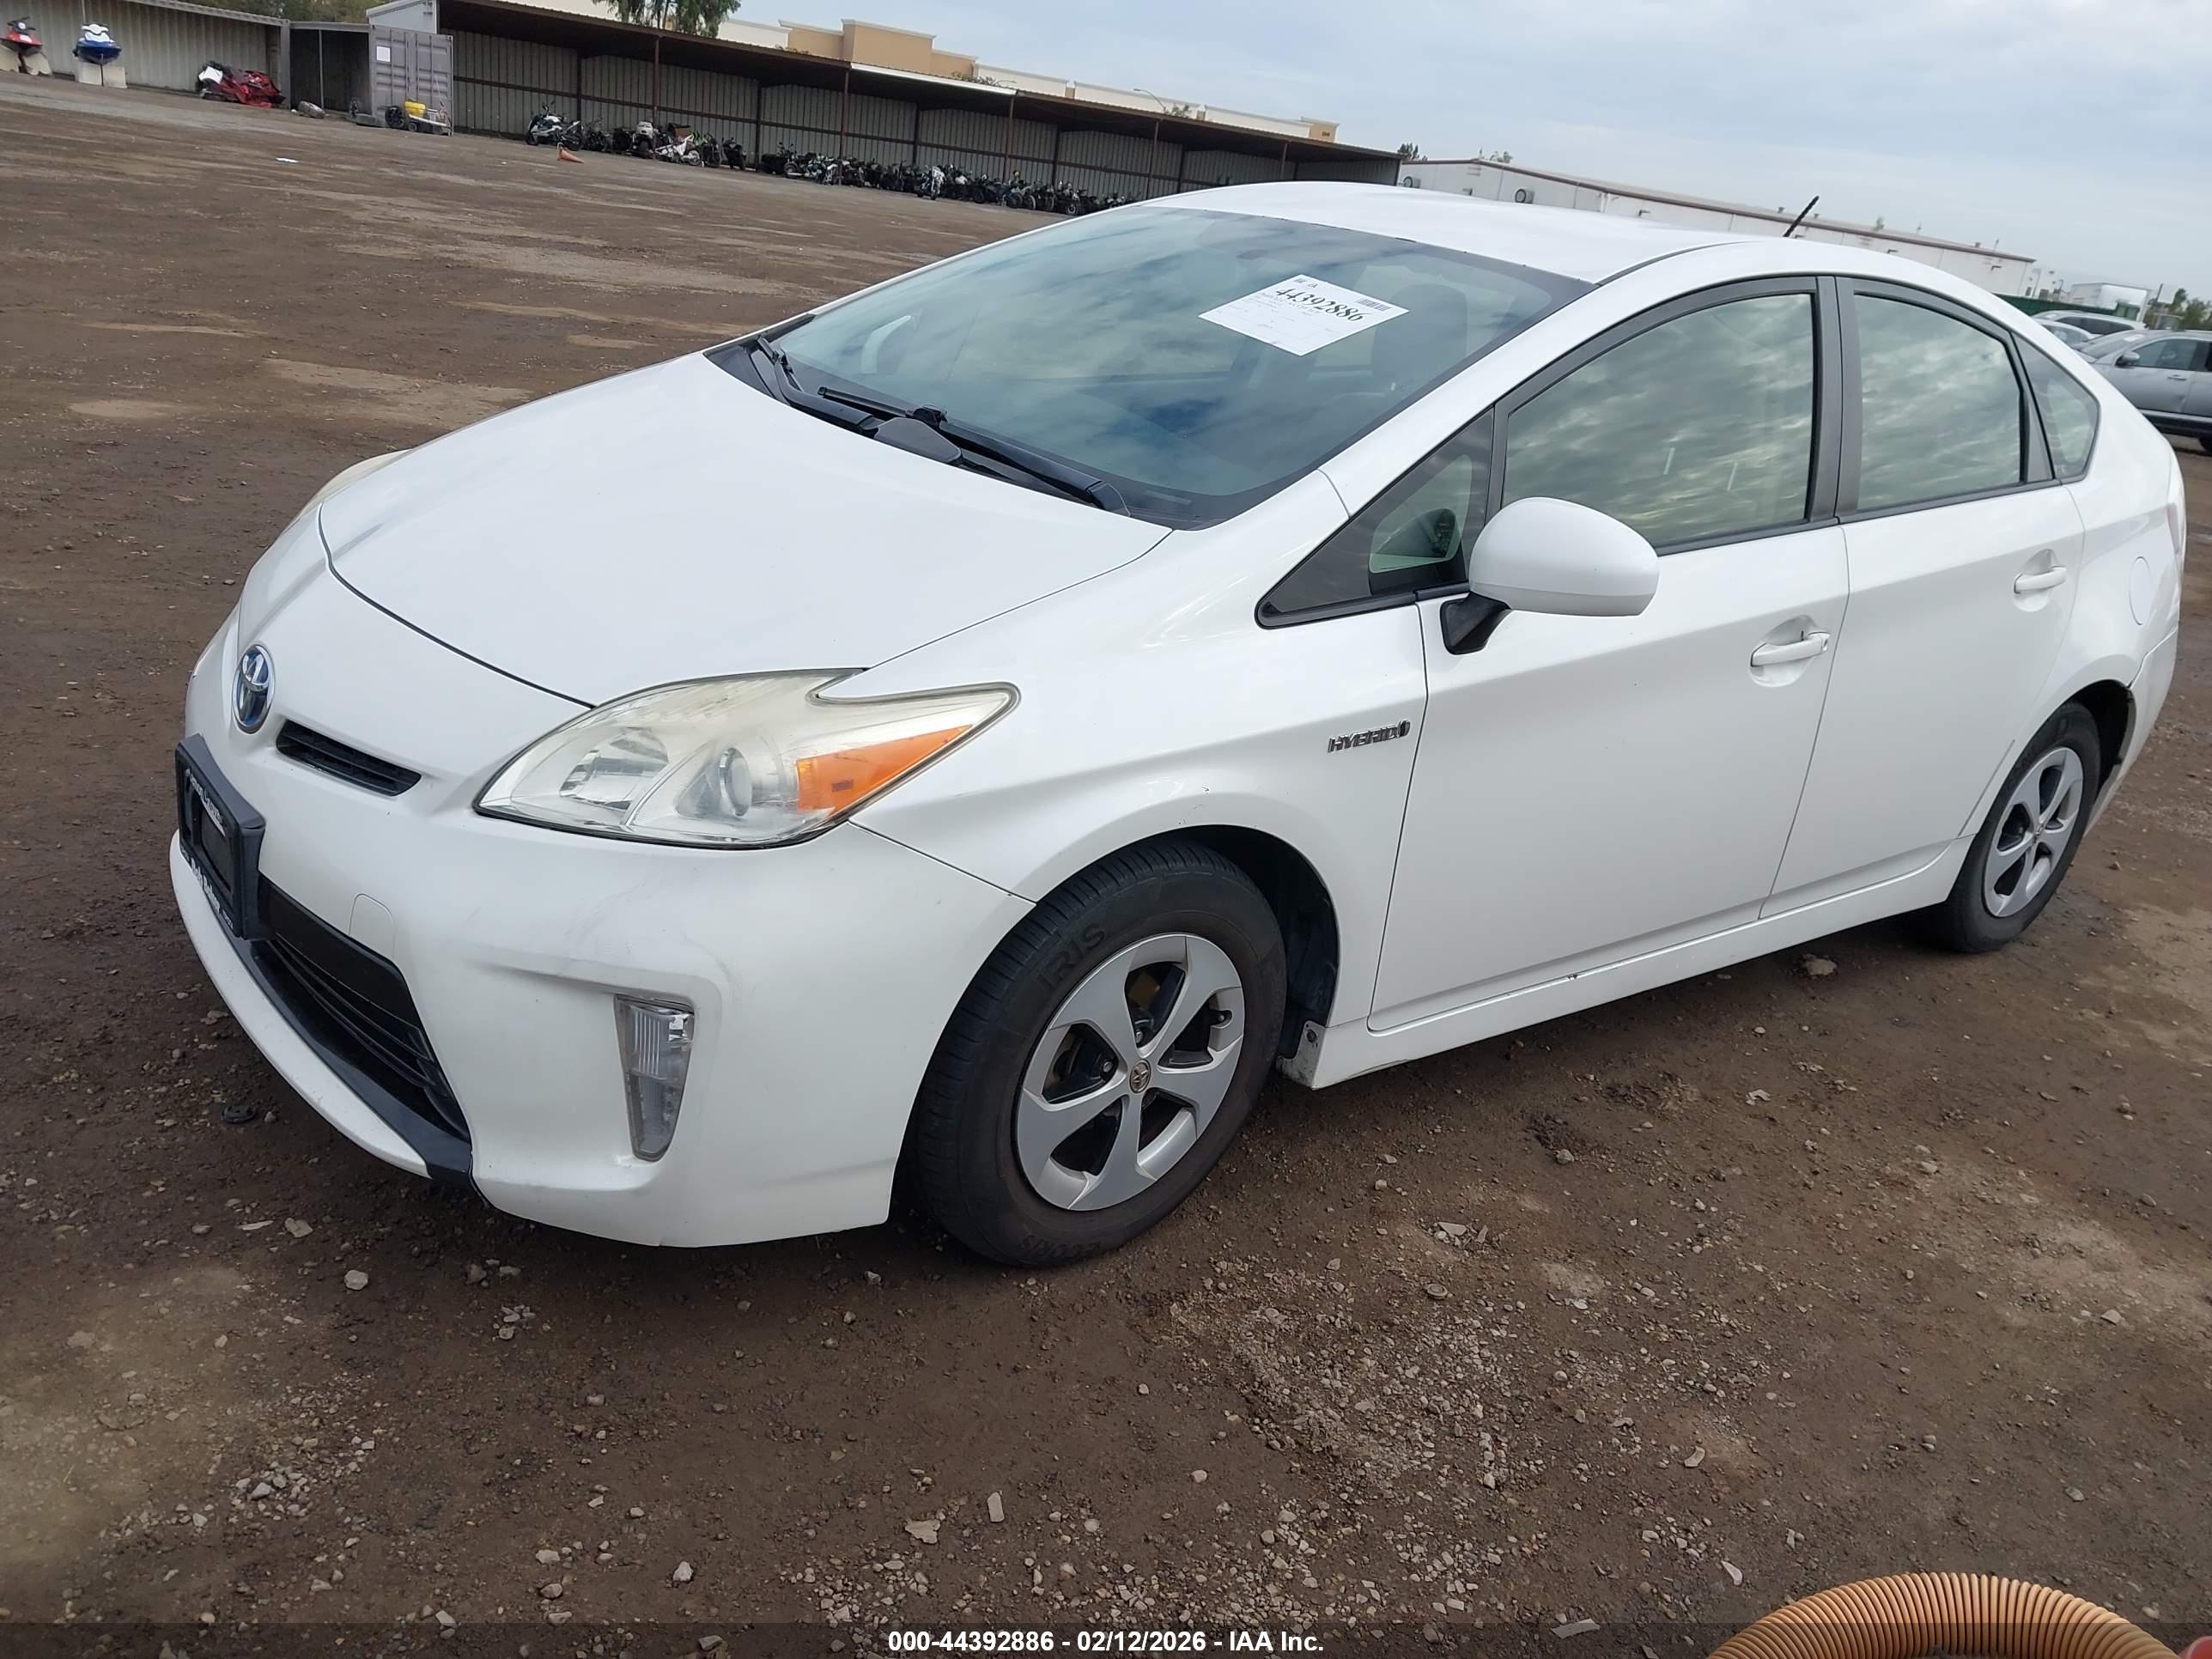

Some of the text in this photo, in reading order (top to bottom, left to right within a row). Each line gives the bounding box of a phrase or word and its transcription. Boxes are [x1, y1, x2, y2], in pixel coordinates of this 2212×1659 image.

[1276, 288, 1372, 322] 44392886
[1328, 723, 1400, 753] HYBRID
[1036, 924, 1106, 991] IRIS
